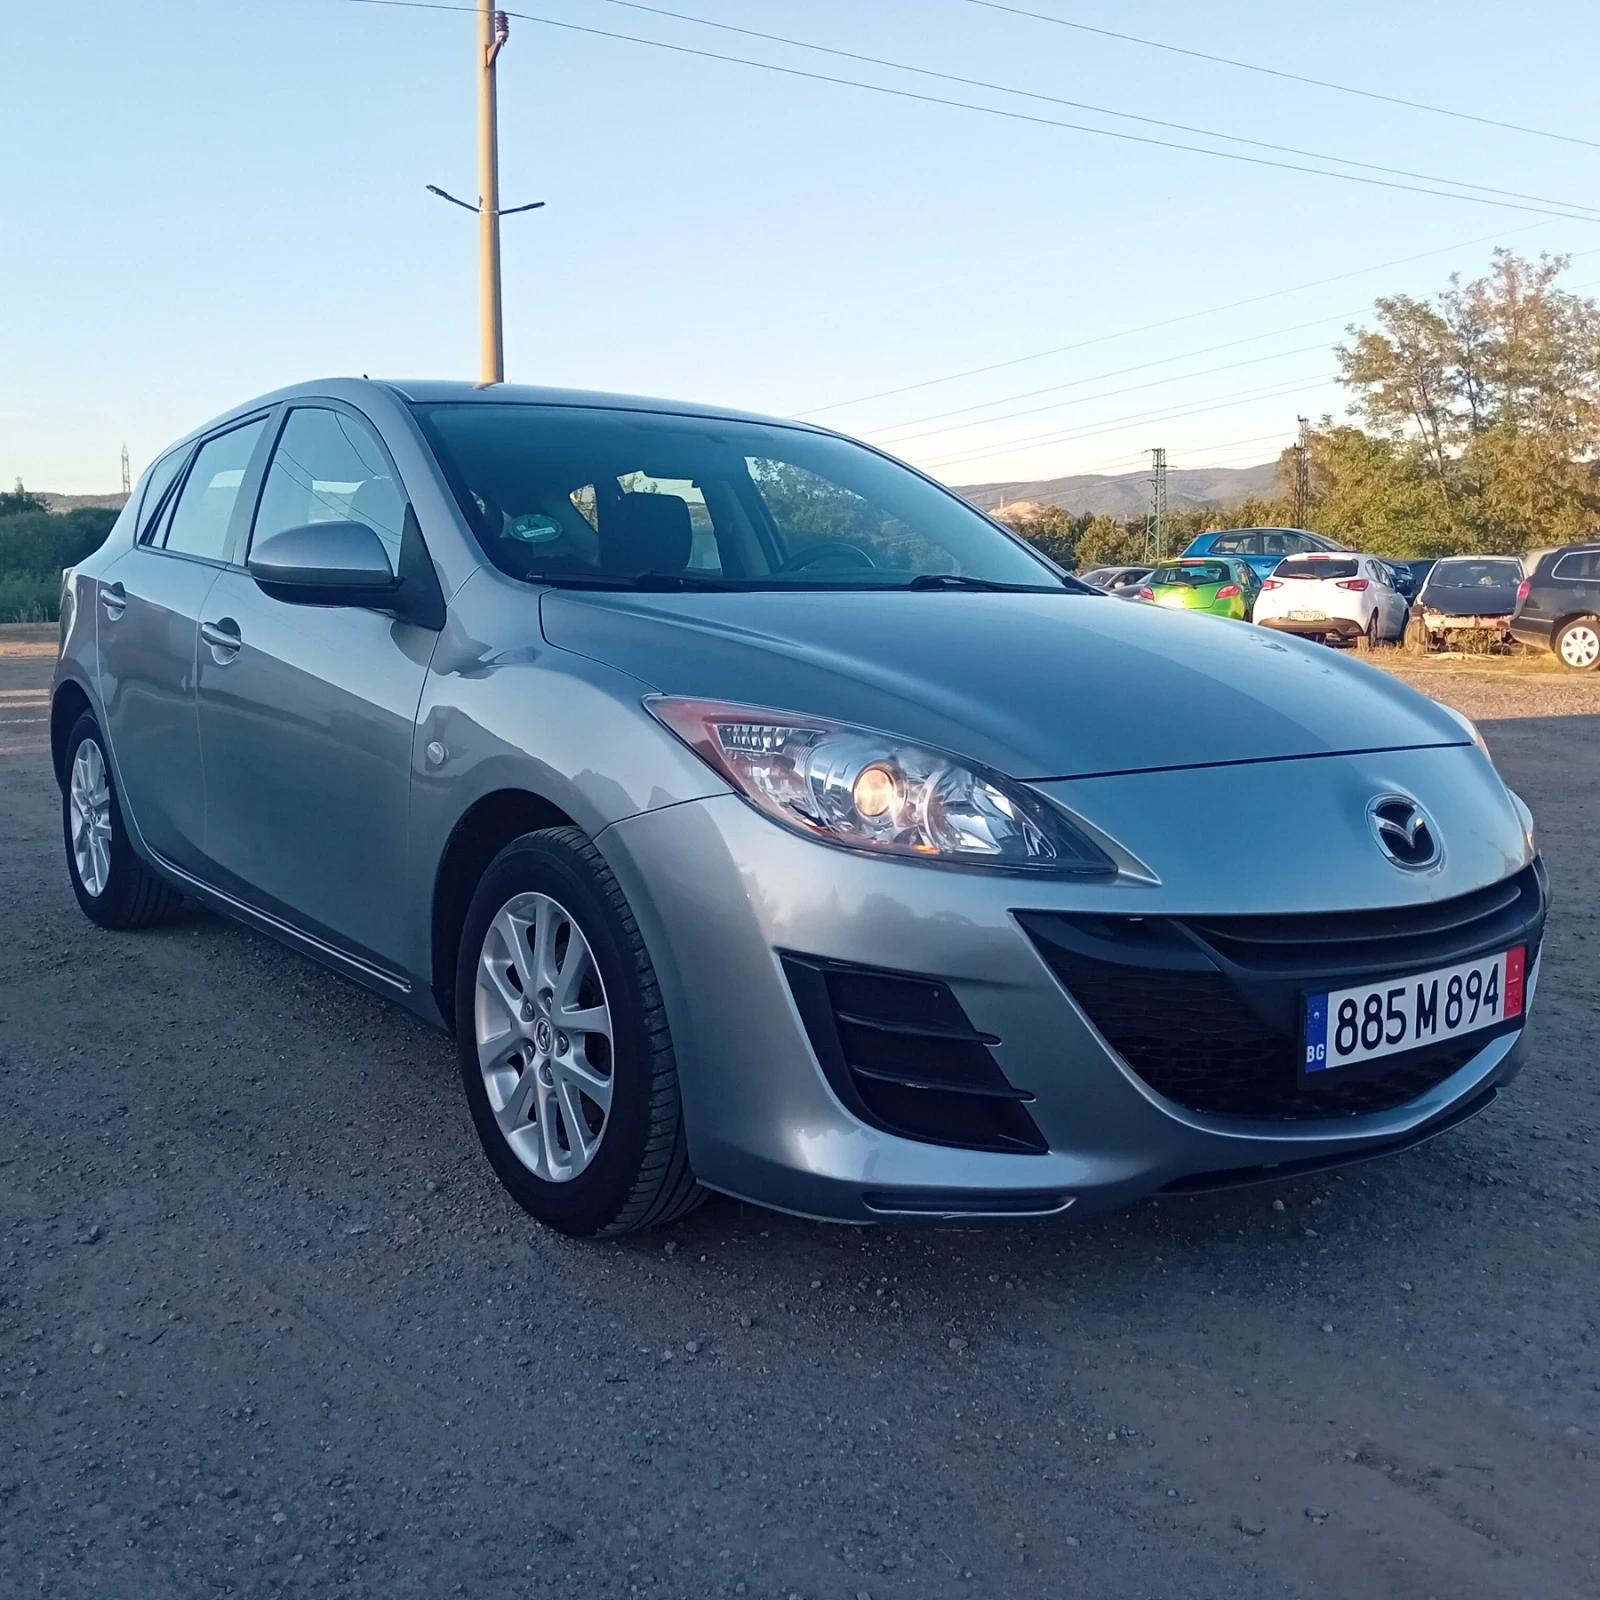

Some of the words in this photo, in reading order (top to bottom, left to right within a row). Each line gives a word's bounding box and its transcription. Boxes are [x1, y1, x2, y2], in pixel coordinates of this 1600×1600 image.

[1334, 988, 1407, 1056] 885
[1415, 979, 1438, 1040] M
[1444, 962, 1499, 1030] 894
[1306, 1043, 1325, 1063] BG
